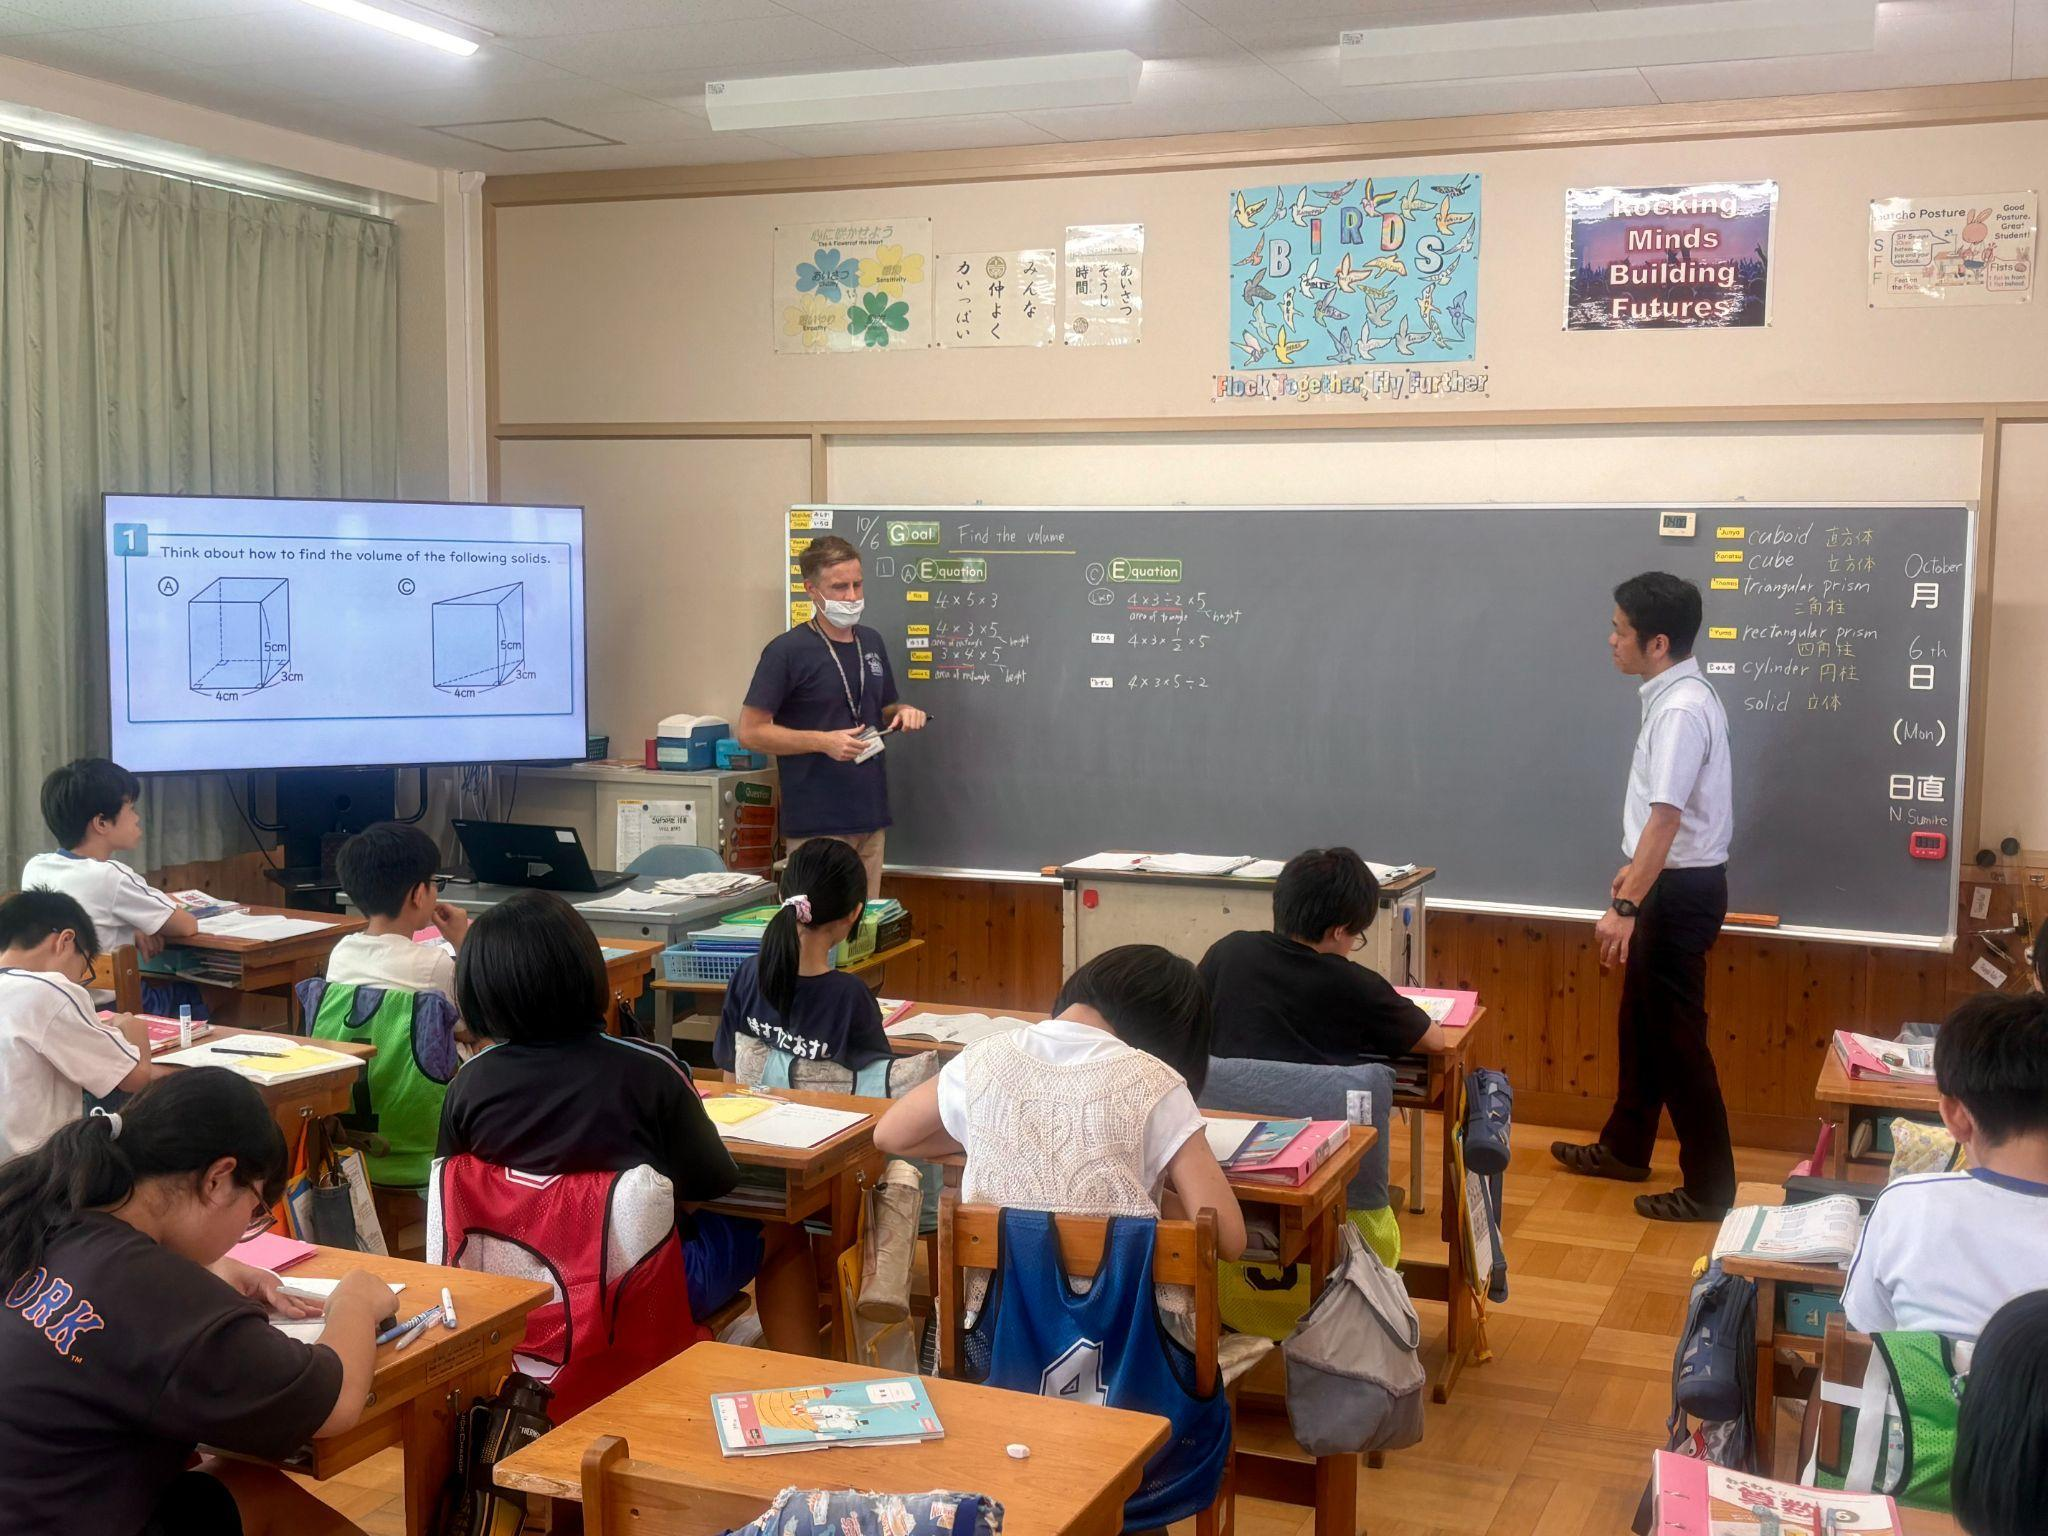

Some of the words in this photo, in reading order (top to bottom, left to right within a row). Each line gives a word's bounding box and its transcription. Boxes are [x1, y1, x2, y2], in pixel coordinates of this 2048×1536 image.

[1920, 209, 1966, 218] Posture
[2004, 204, 2024, 212] Good
[1269, 206, 1444, 278] BIRDS
[1628, 227, 1718, 252] Minds
[1874, 239, 1884, 252] S
[1995, 232, 2030, 240] Student!
[1874, 256, 1882, 268] F
[1990, 264, 2012, 272] Fists
[811, 270, 850, 282] あいさつ
[1076, 266, 1088, 295] 時間
[1098, 264, 1110, 306] そうじ
[1610, 262, 1736, 288] Building
[1873, 272, 1882, 285] F
[1022, 261, 1038, 318] みんな
[1120, 264, 1132, 316] あいさつ
[988, 283, 1005, 340] 仲よく
[1612, 297, 1730, 320] Futures
[1217, 376, 1270, 397] Flock
[1276, 373, 1367, 401] Together,
[1373, 371, 1402, 400] Fly
[1408, 371, 1488, 394] Further
[122, 529, 136, 552] 1
[890, 524, 932, 543] Goal
[958, 524, 988, 544] Find
[996, 526, 1016, 544] the
[1027, 525, 1066, 544] volume
[1748, 522, 1814, 545] cuboid
[1825, 526, 1874, 548] 直方体
[160, 546, 200, 561] Think
[204, 546, 246, 562] about
[249, 547, 276, 562] how
[280, 550, 295, 562] to
[298, 547, 328, 562] find
[330, 548, 352, 562] the
[356, 548, 402, 562] volume
[406, 548, 421, 563] of
[424, 549, 446, 563] the
[449, 549, 507, 566] following
[511, 550, 551, 564] solids.
[1748, 550, 1794, 570] cube
[1828, 554, 1876, 573] 立方体
[1904, 553, 1963, 578] October
[920, 562, 984, 578] Equation
[1112, 562, 1178, 578] Equation
[1823, 579, 1870, 598] prism
[1910, 582, 1940, 610] 月
[1794, 598, 1846, 616] 三角柱
[1742, 622, 1828, 646] rectangular
[1836, 627, 1878, 647] prism
[264, 640, 288, 654] 5cm
[500, 640, 522, 652] 5cm
[1798, 640, 1857, 658] 四角柱
[281, 670, 304, 682] 3cm
[515, 669, 537, 681] 3cm
[1742, 658, 1810, 682] cylinder
[1820, 663, 1860, 682] 円柱
[1909, 664, 1935, 690] 日
[216, 690, 240, 702] 4cm
[454, 688, 476, 700] 4cm
[1744, 690, 1791, 712] solid
[1807, 692, 1842, 712] 立体
[1890, 774, 1946, 802] 日直
[1890, 806, 1901, 822] N
[1040, 1337, 1108, 1407] 4
